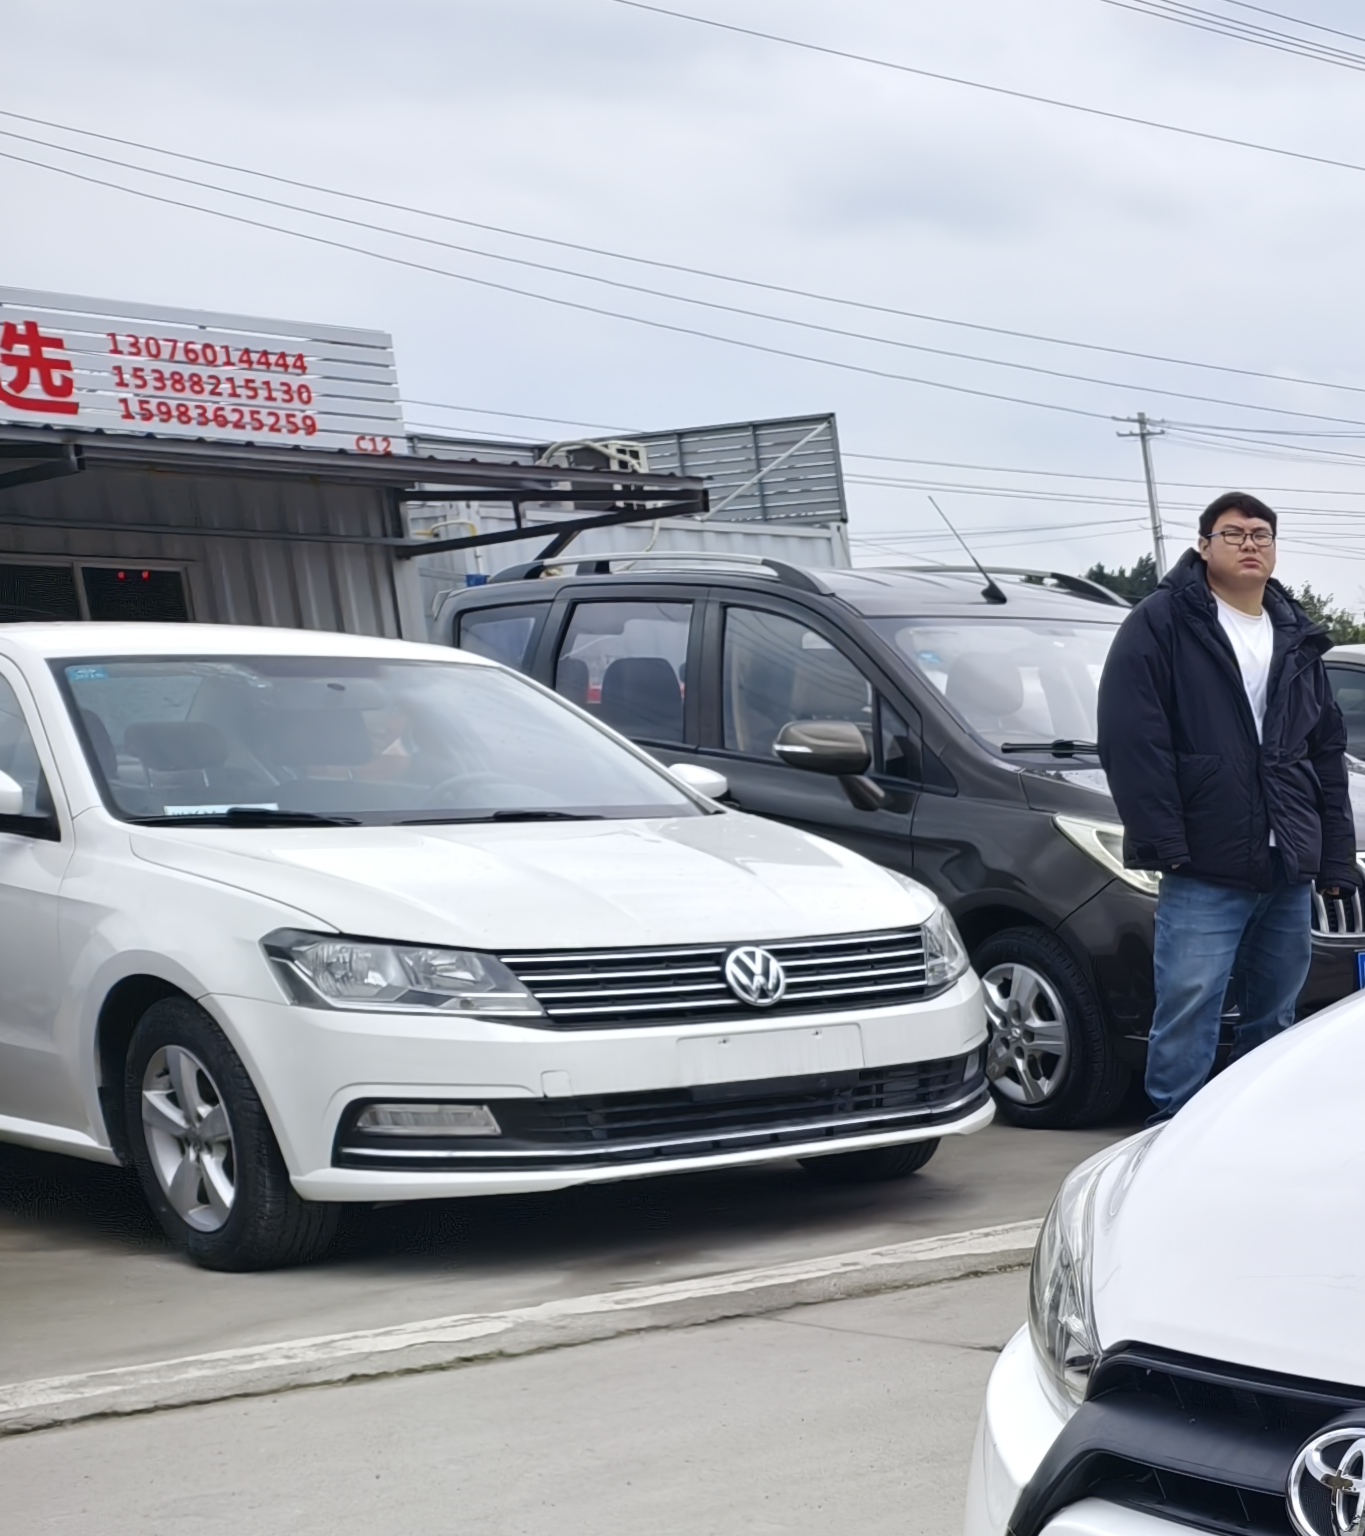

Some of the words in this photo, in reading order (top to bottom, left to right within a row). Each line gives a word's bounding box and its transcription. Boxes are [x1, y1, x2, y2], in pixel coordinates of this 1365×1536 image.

[106, 332, 307, 374] 13076014444
[112, 365, 312, 405] 15388215130
[118, 398, 318, 436] 15983625259
[355, 435, 393, 457] C12
